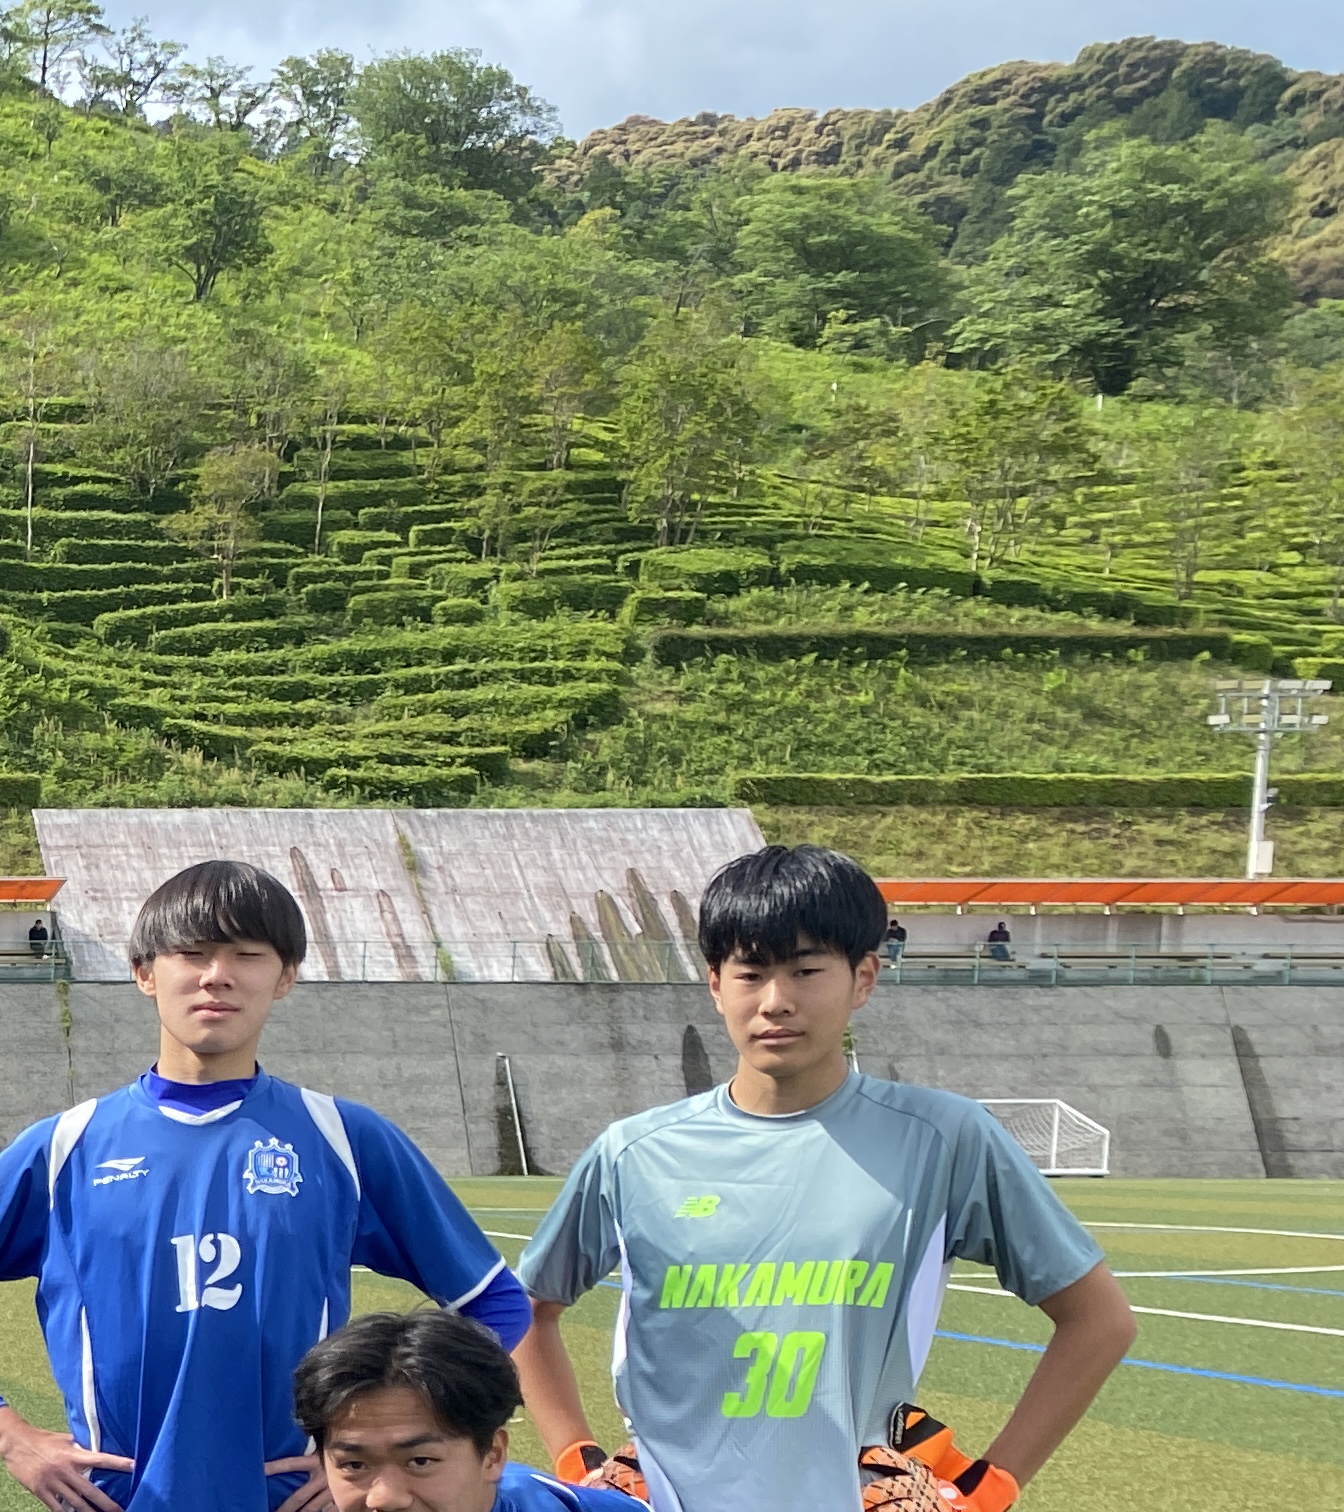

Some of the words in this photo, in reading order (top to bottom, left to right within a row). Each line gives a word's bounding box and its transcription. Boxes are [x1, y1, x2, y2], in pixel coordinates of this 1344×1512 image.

[93, 1169, 149, 1186] PENALTY
[170, 1233, 243, 1313] 12
[659, 1259, 895, 1309] NAKAMURA
[721, 1331, 827, 1418] 30
